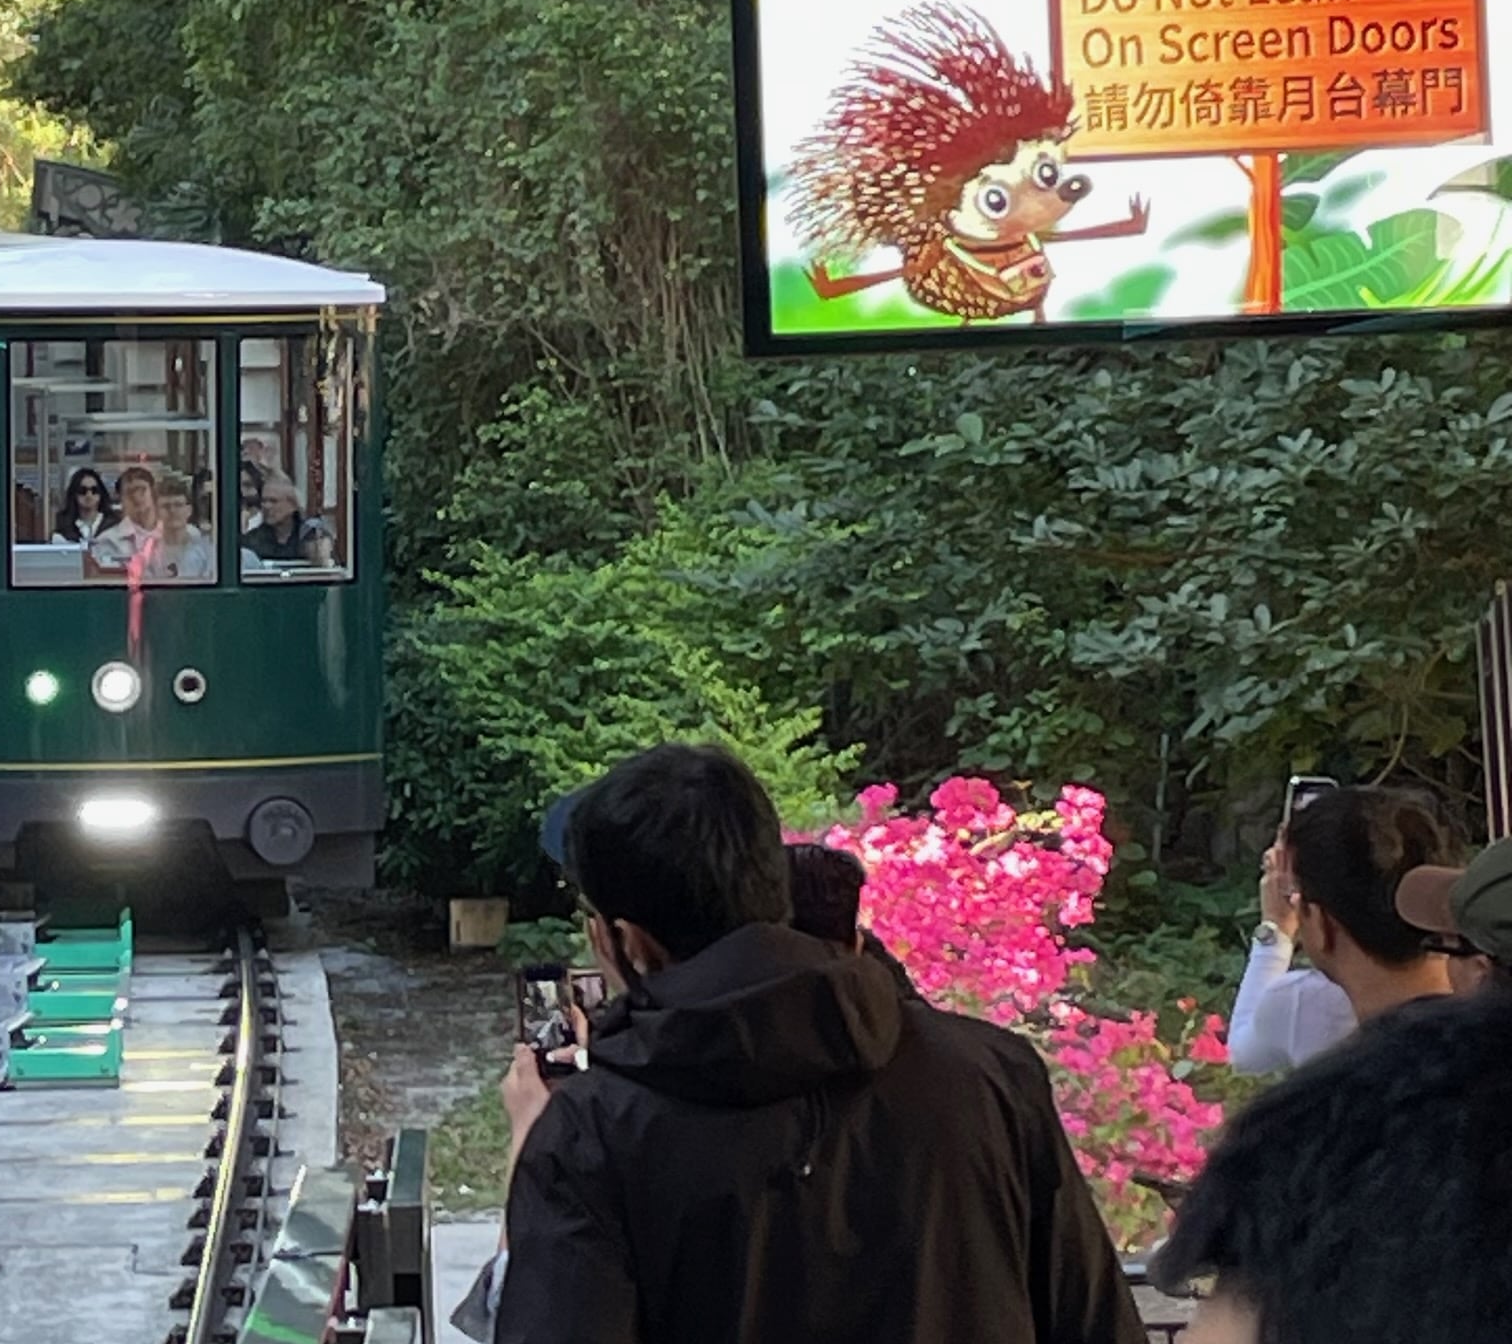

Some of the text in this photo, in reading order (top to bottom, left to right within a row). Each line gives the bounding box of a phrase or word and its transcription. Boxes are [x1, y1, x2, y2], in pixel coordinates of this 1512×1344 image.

[1081, 15, 1460, 68] On Screen Doors
[1084, 67, 1464, 132] 請勿倚靠月台幕門
